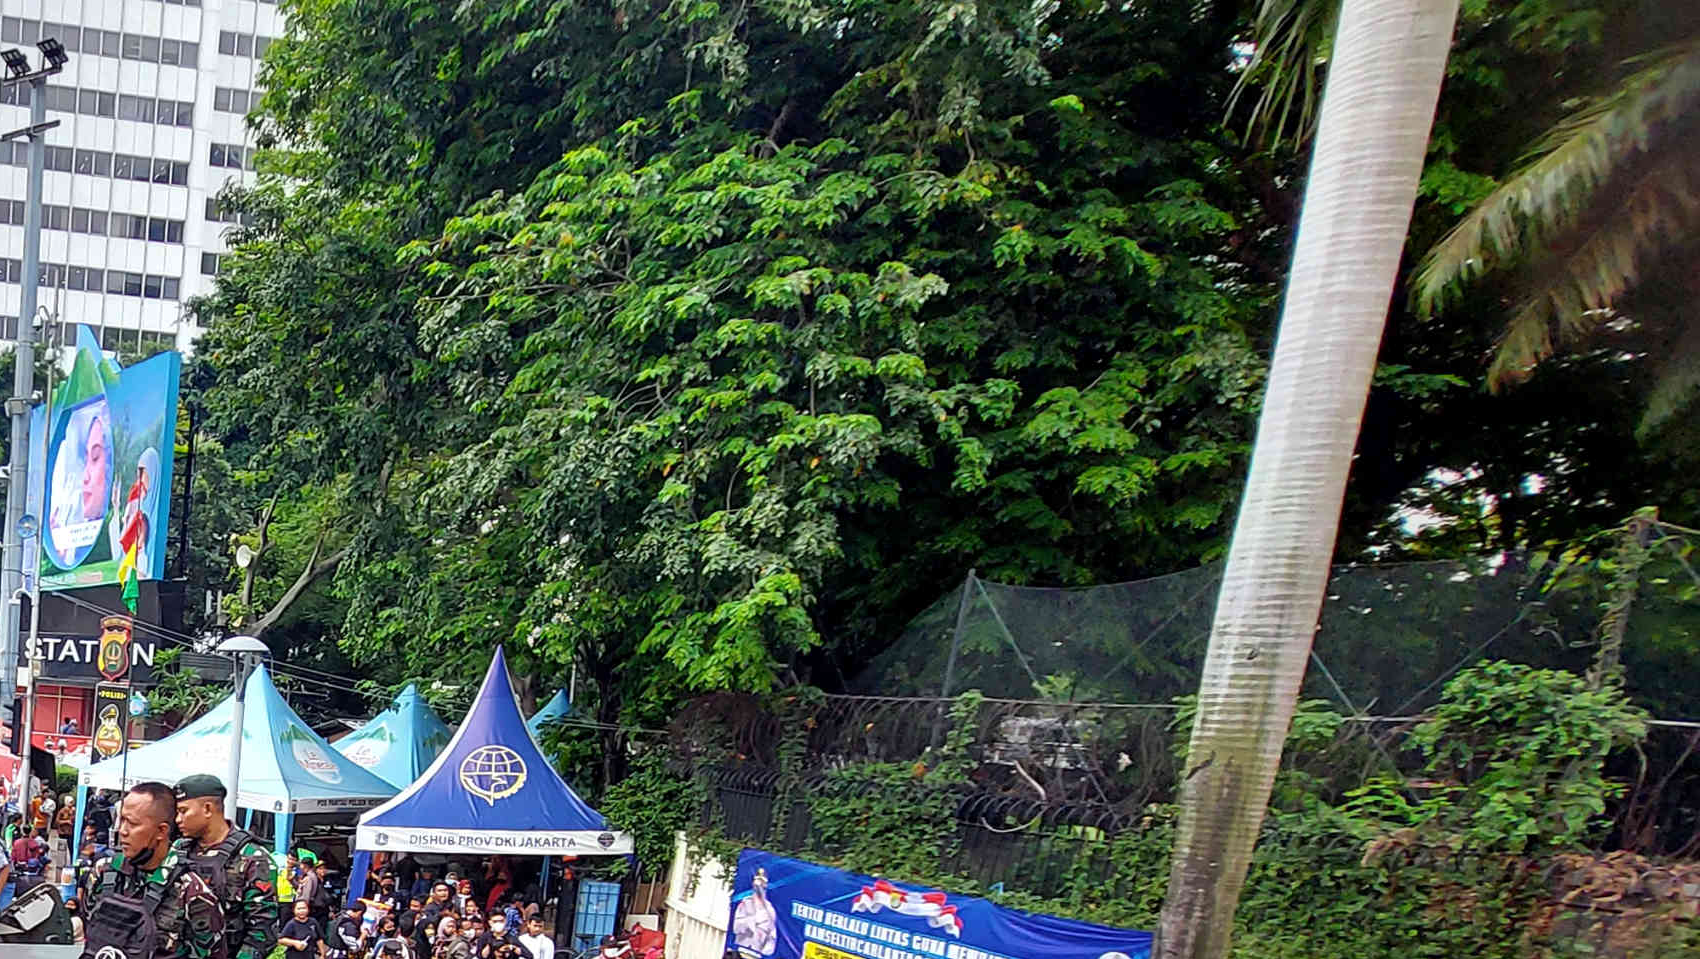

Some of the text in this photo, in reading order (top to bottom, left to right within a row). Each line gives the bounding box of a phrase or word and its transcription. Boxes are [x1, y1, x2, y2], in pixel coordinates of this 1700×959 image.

[24, 637, 155, 667] STATN
[408, 833, 576, 849] DISHUB PROV DKI JAKARTA
[870, 922, 910, 947] LINTAS
[912, 934, 947, 956] GUNA
